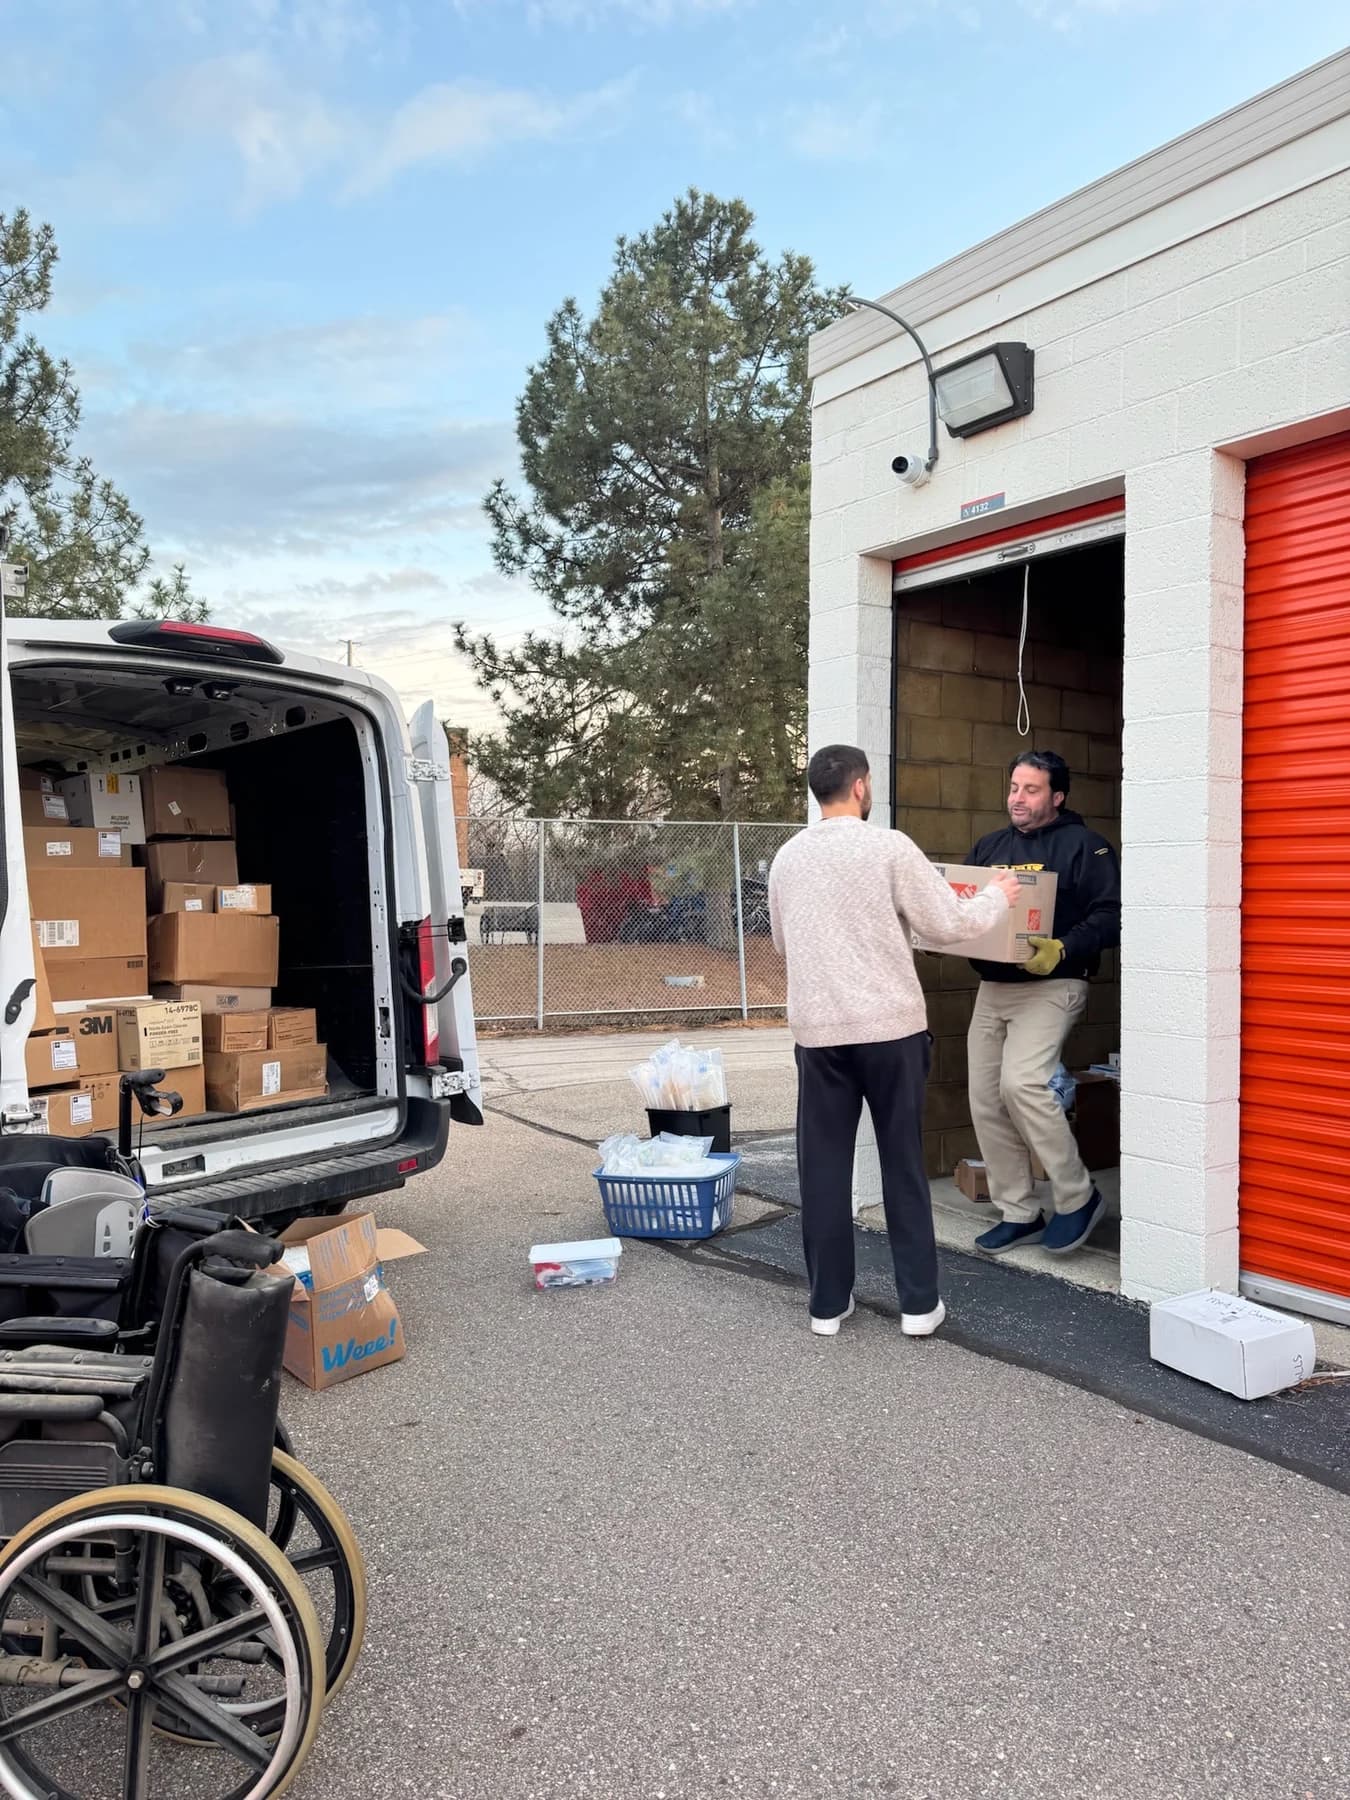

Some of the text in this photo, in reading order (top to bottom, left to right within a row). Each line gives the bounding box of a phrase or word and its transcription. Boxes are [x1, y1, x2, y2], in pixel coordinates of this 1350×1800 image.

[971, 502, 989, 513] 4132
[164, 1004, 198, 1014] 14-6978C
[79, 1015, 113, 1036] 3M
[321, 1318, 397, 1373] Weee!
